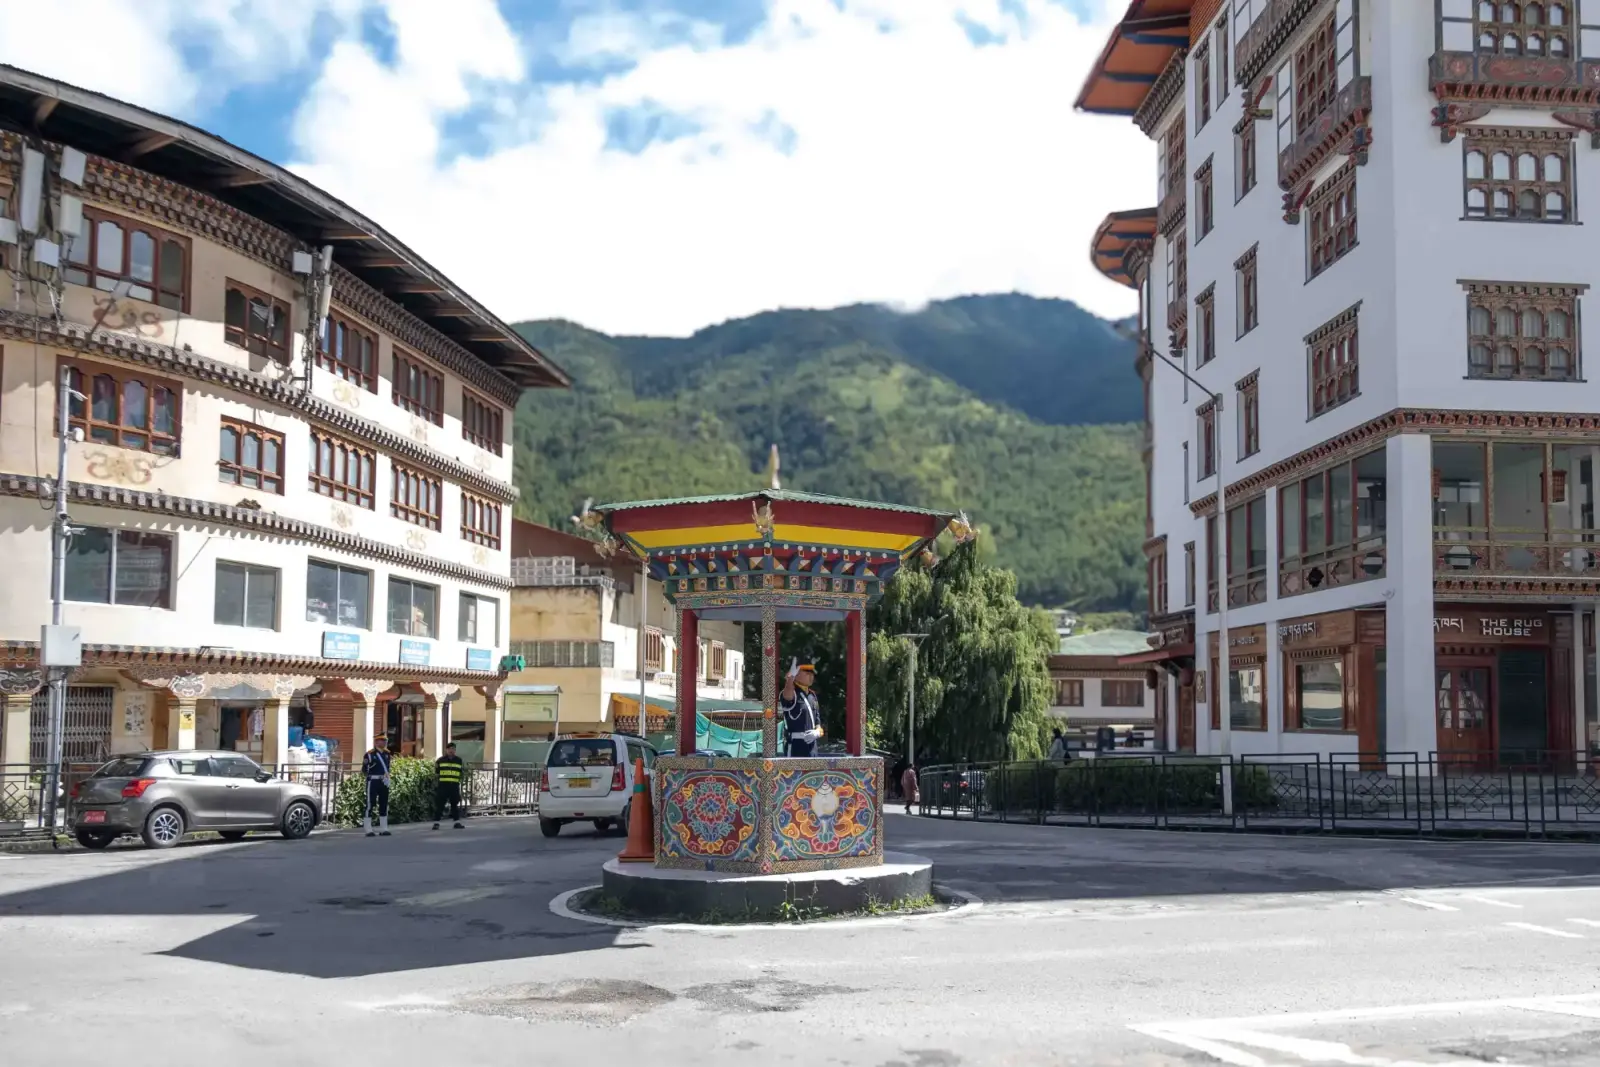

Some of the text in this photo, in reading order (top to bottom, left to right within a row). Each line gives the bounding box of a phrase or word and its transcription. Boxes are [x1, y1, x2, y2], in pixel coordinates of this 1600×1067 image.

[1479, 618, 1543, 628] THE RUG
[1481, 627, 1531, 637] HOUSE
